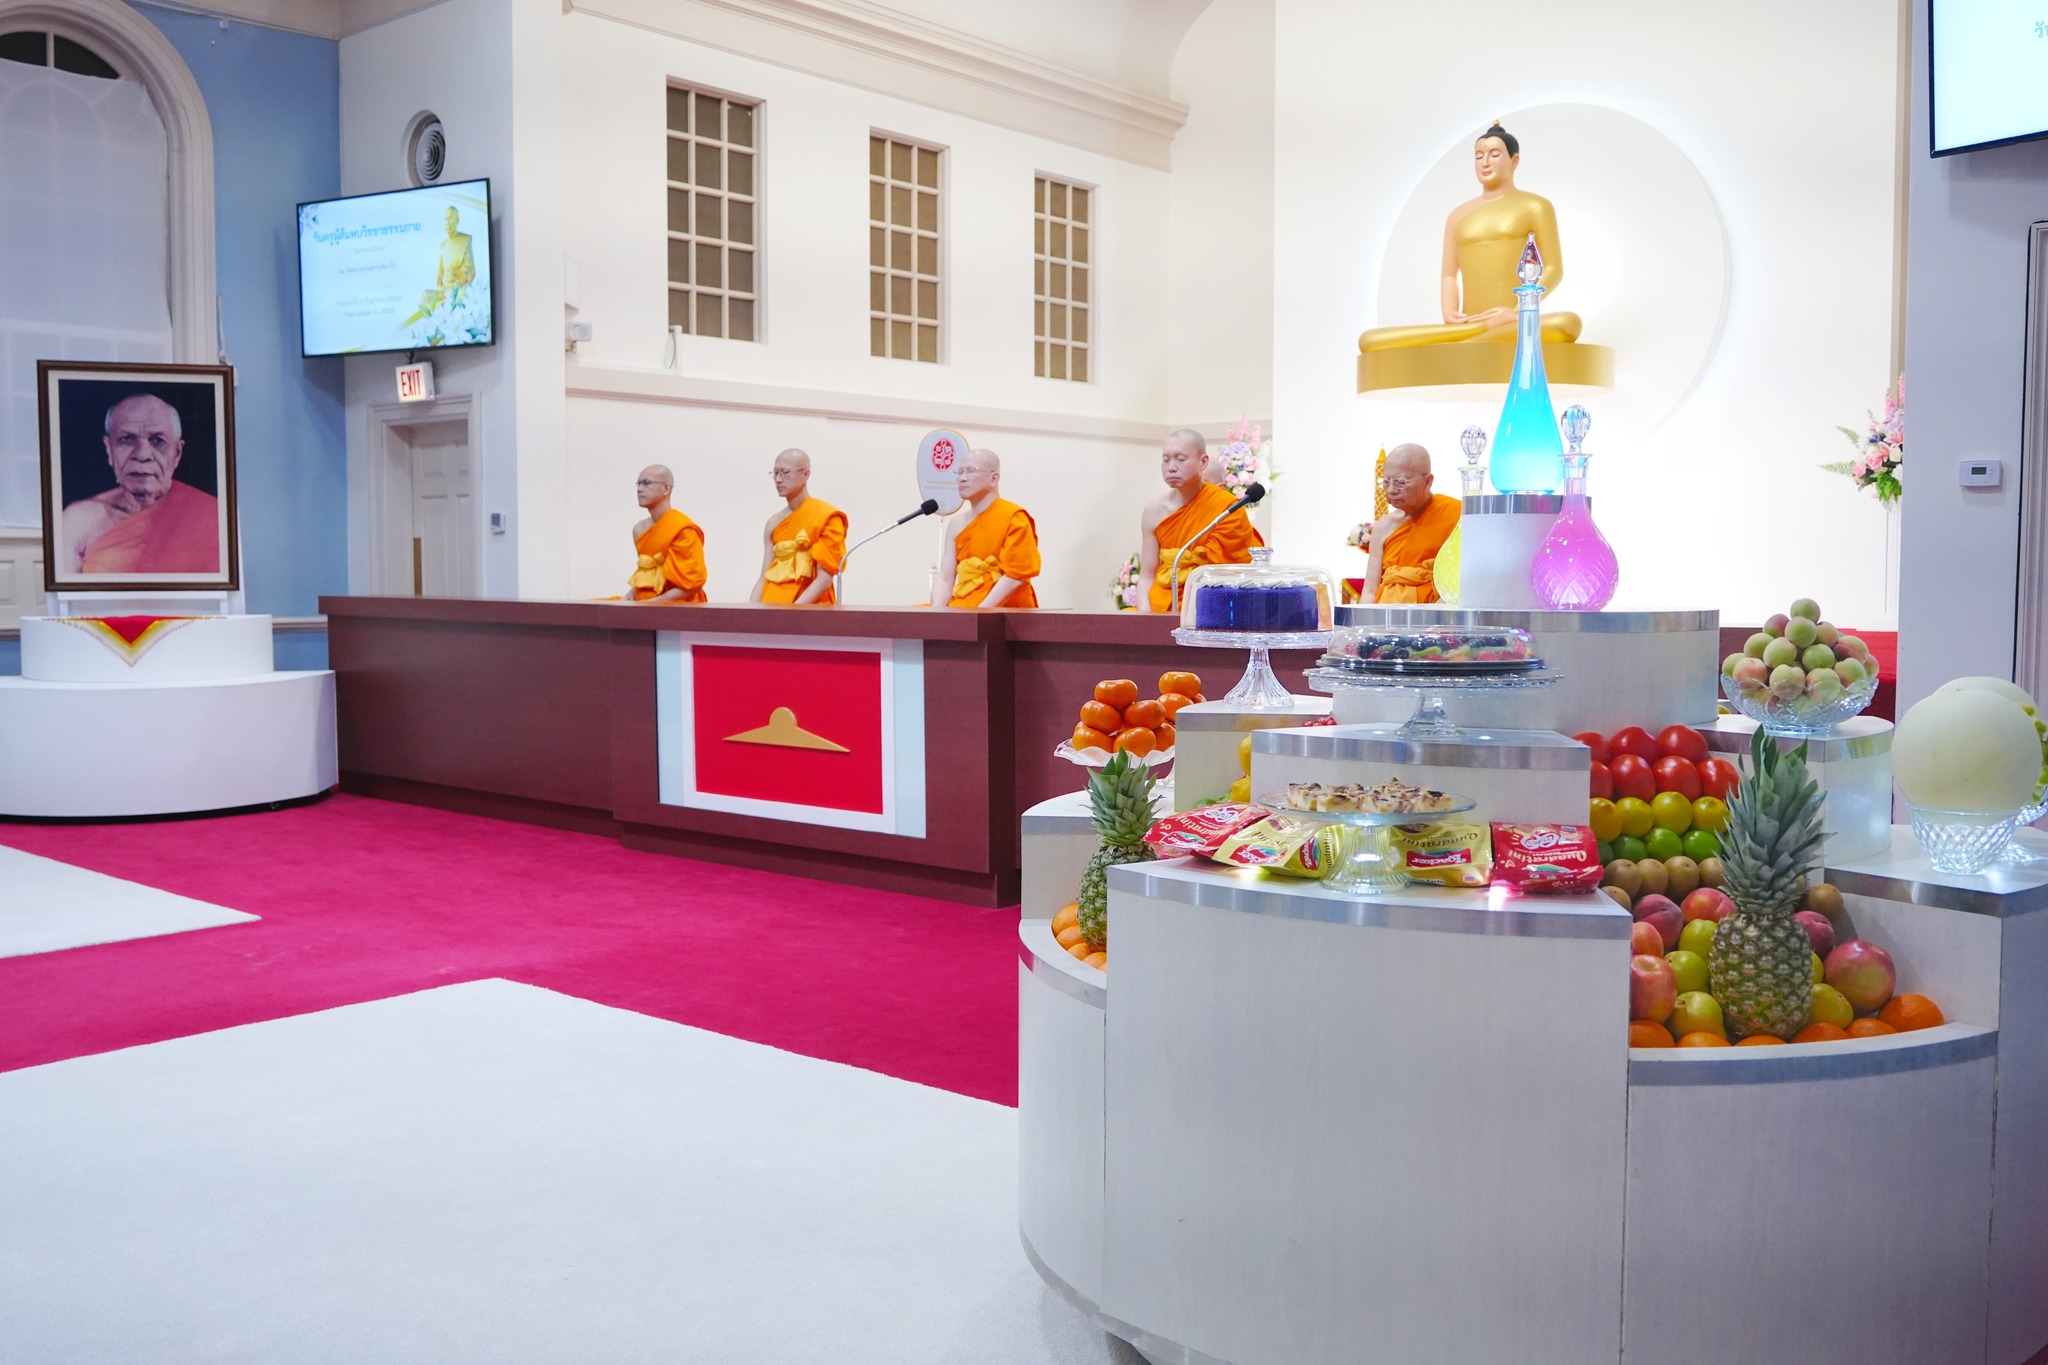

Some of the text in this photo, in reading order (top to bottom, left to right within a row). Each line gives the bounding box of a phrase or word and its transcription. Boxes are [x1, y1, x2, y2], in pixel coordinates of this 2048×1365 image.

[400, 369, 421, 397] EXIT
[1401, 832, 1479, 849] Quadratini
[1507, 849, 1588, 864] Quadratini
